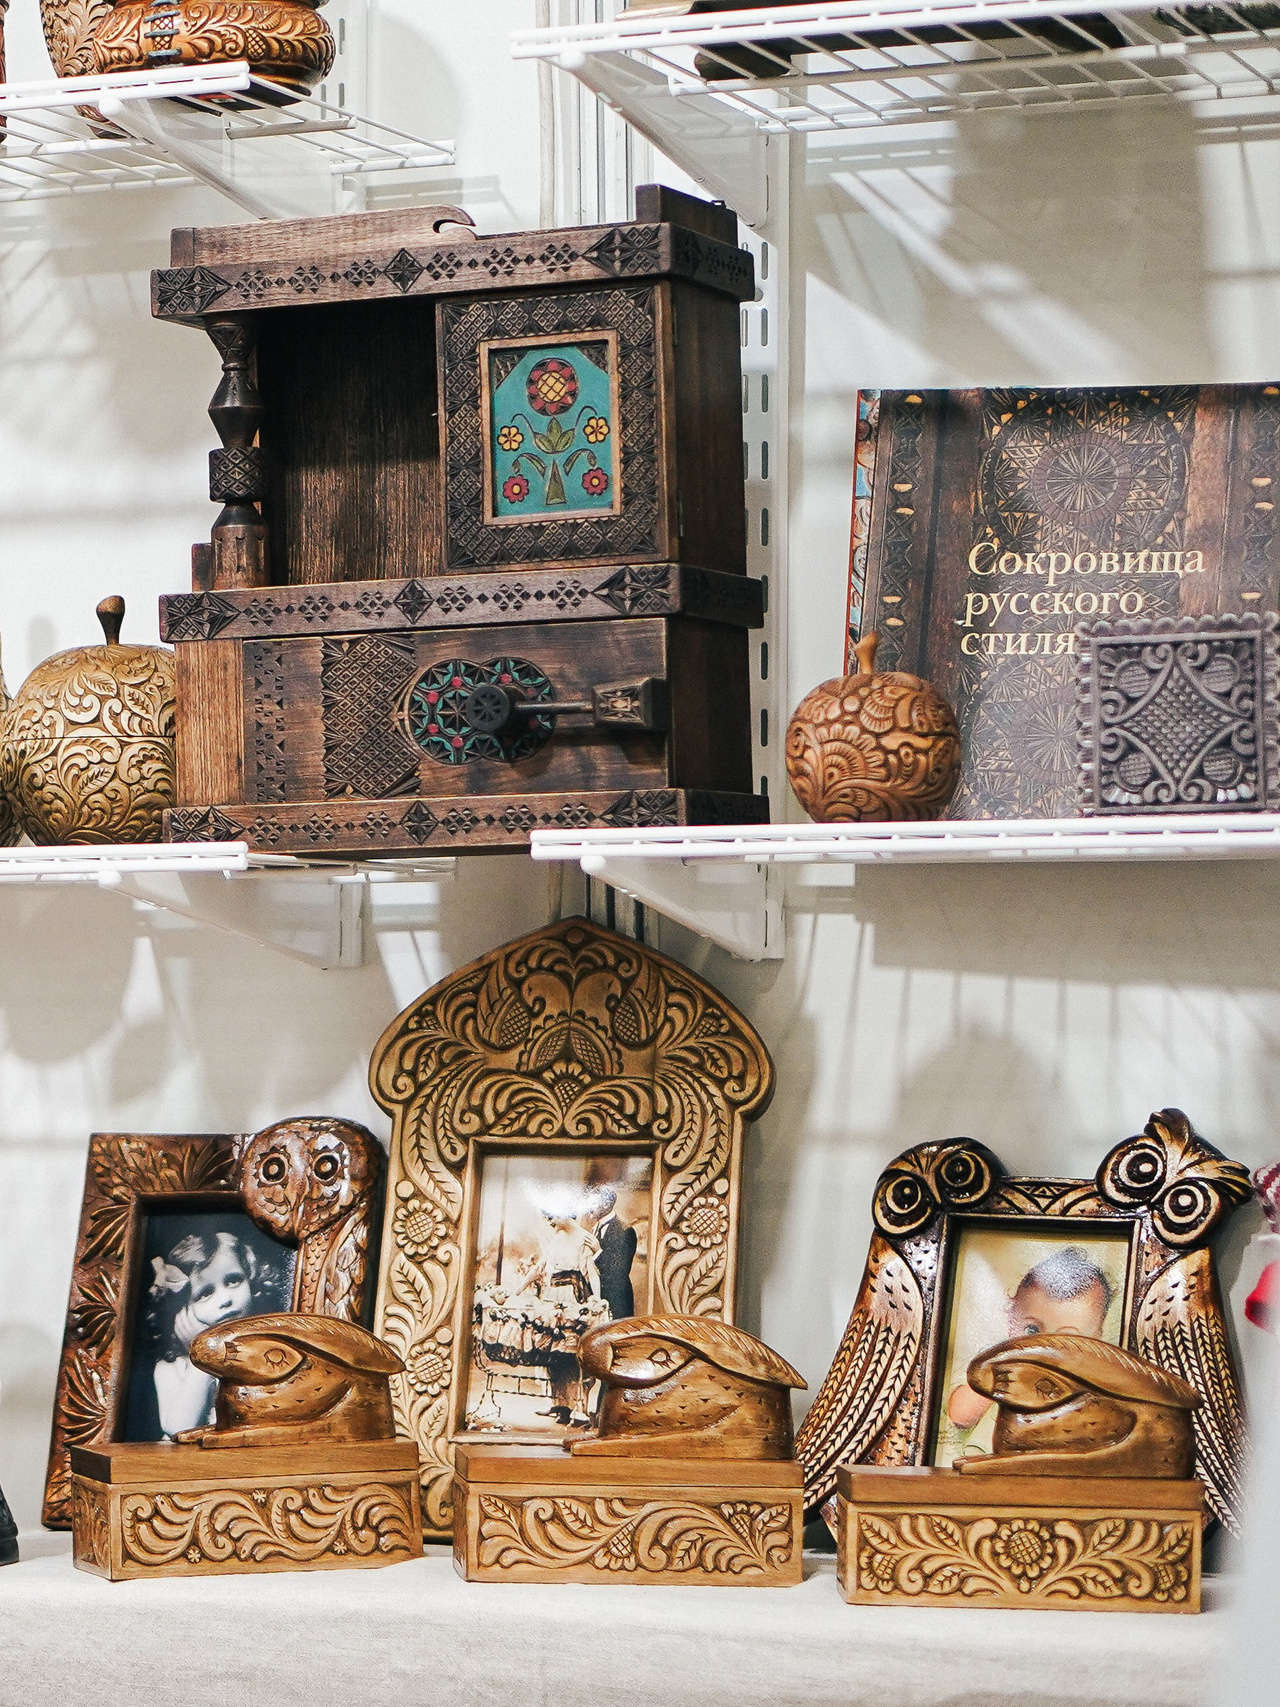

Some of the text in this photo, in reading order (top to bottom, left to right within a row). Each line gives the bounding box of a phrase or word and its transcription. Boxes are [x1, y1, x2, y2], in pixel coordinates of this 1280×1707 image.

[968, 542, 1206, 587] Сокровища
[963, 591, 1144, 628] русского
[960, 631, 1076, 656] стиля
